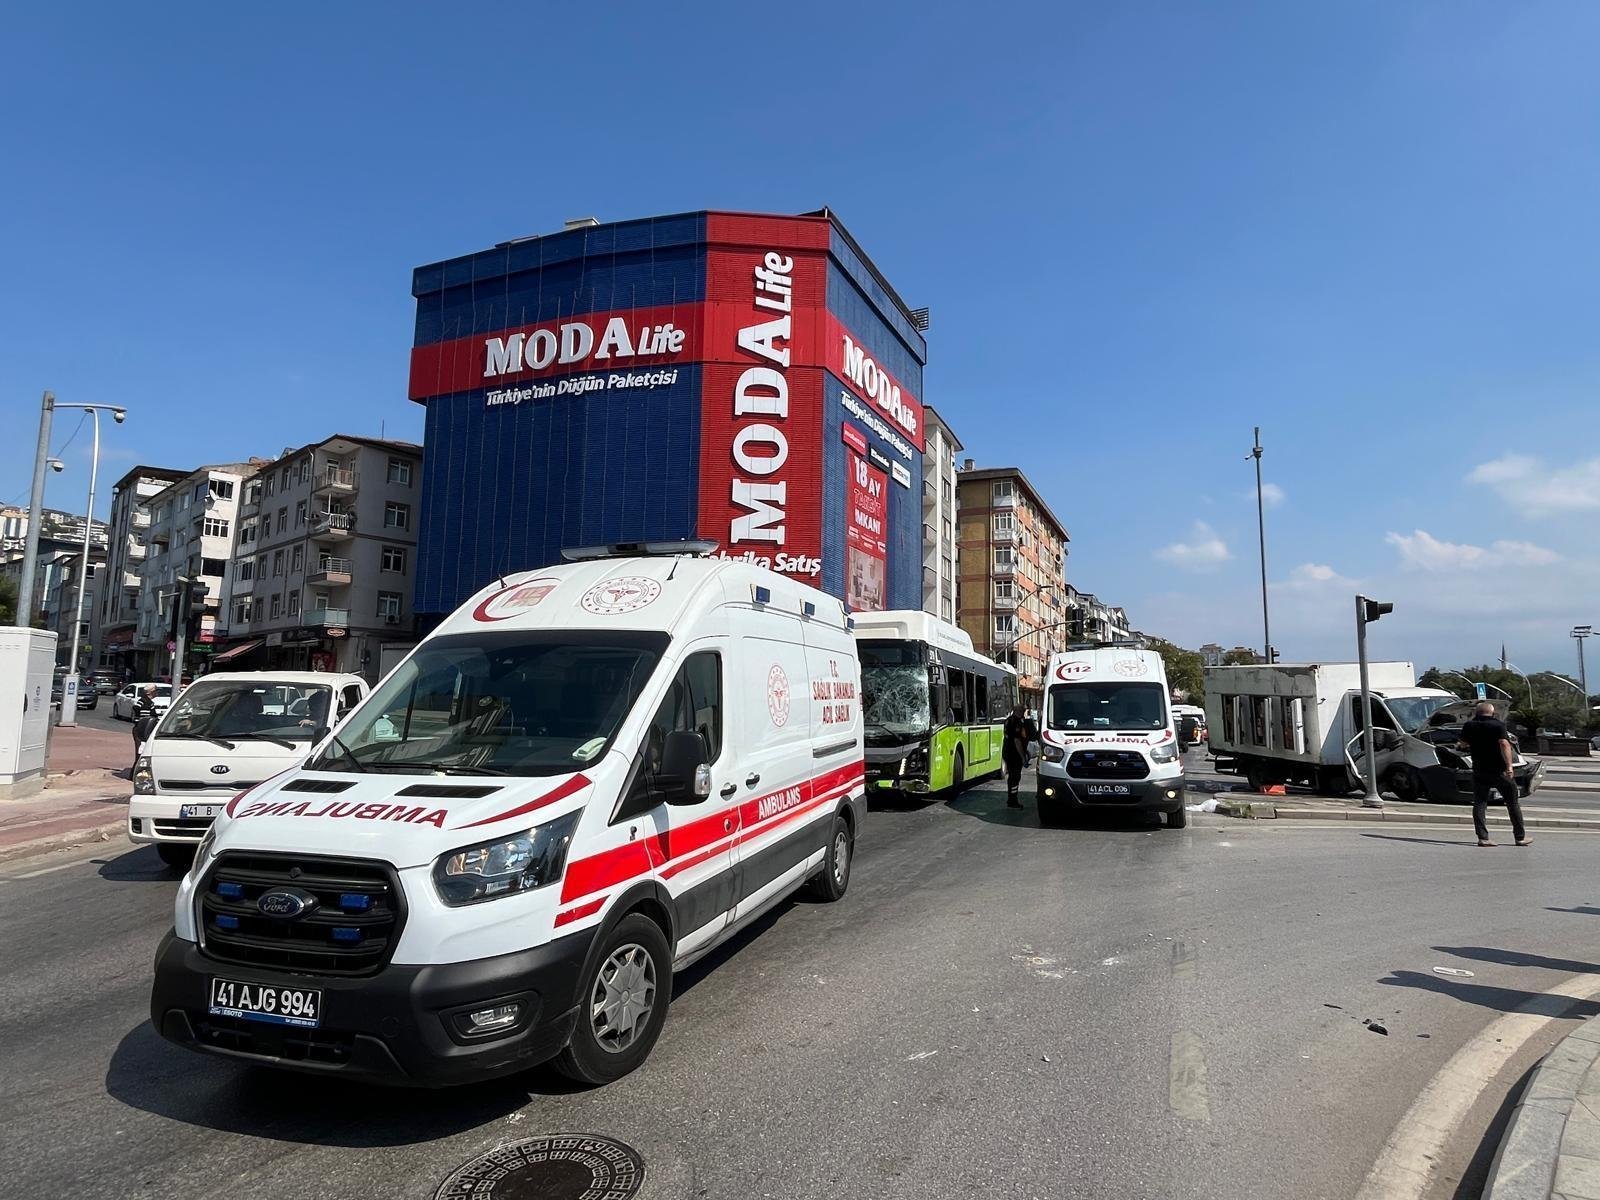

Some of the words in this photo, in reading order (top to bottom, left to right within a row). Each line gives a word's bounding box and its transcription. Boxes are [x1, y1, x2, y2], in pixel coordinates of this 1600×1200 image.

[755, 251, 794, 312] Life
[484, 317, 635, 377] MODA
[637, 323, 686, 356] Life
[486, 383, 556, 407] Türkiye'nin
[557, 375, 605, 396] Düğün
[607, 369, 678, 390] Paketçisi
[842, 334, 903, 425] MODA
[901, 405, 917, 436] Life
[730, 314, 791, 545] MODA
[854, 455, 868, 488] 18
[868, 477, 881, 498] AY
[773, 552, 821, 577] Satış
[1065, 666, 1091, 674] 112
[758, 786, 801, 820] AMBULANS
[1098, 785, 1113, 793] ACL
[188, 806, 198, 816] 41
[206, 806, 212, 816] B
[263, 896, 291, 913] Ford
[217, 982, 235, 1007] 41
[238, 985, 276, 1012] AJG
[280, 990, 315, 1017] 994
